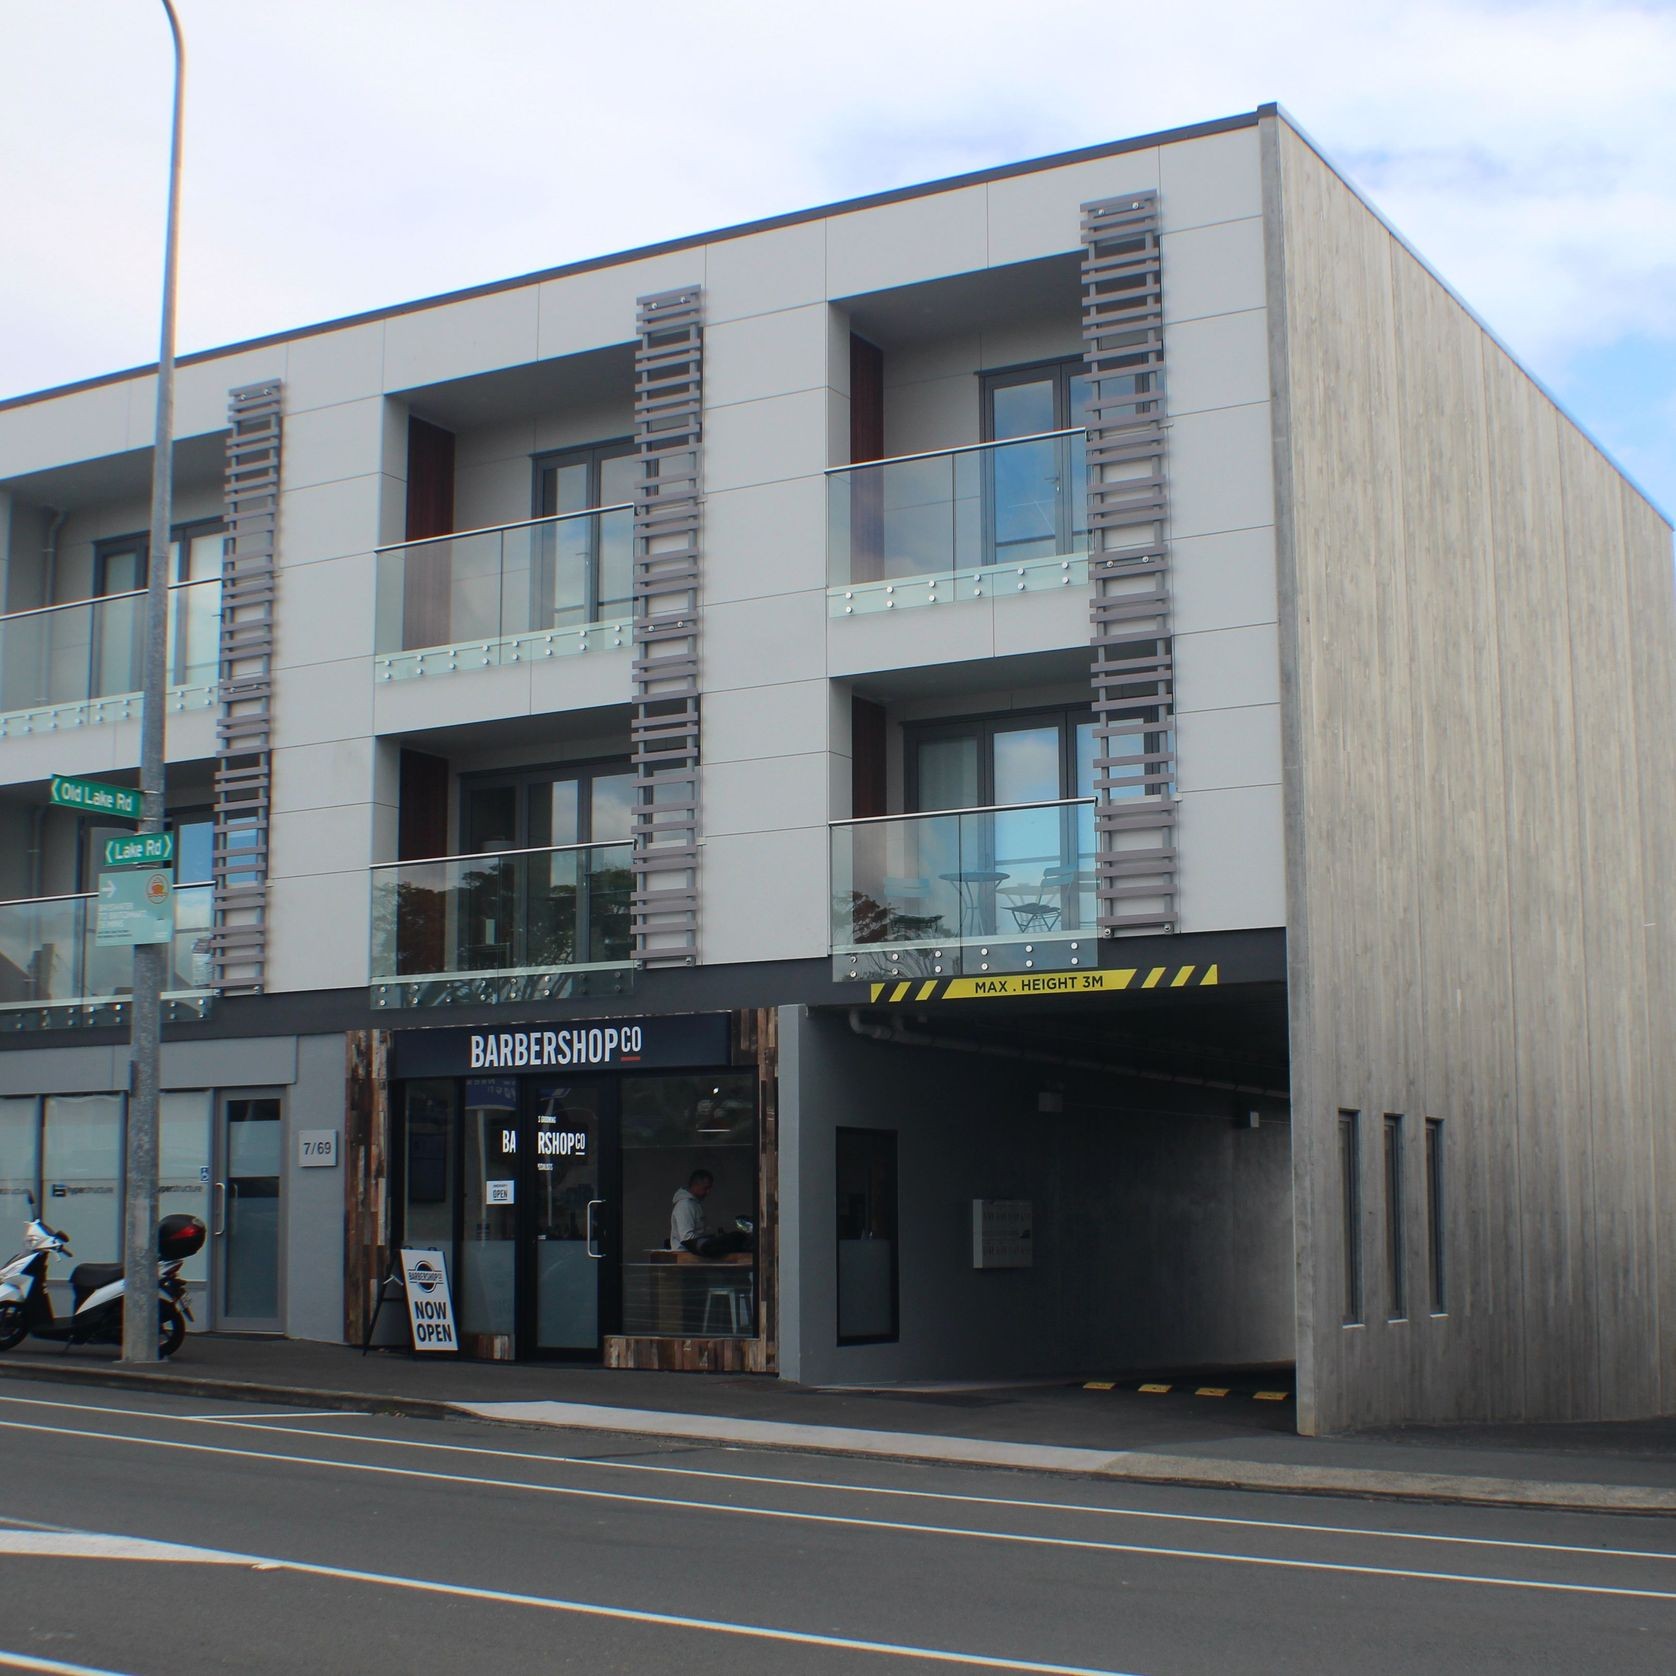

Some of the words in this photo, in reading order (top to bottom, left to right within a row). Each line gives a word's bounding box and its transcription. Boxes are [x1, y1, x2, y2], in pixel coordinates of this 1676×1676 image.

[61, 783, 82, 802] Old
[84, 787, 113, 808] Lake
[116, 793, 133, 812] Rd
[115, 843, 143, 860] Lake
[145, 840, 162, 856] Rd
[975, 981, 1008, 994] MAX
[1021, 976, 1078, 991] HEIGHT
[1083, 976, 1104, 988] 3M
[303, 1141, 332, 1155] 7/69
[492, 1189, 508, 1199] OPEN
[414, 1301, 447, 1320] NOW
[417, 1323, 452, 1342] OPEN
